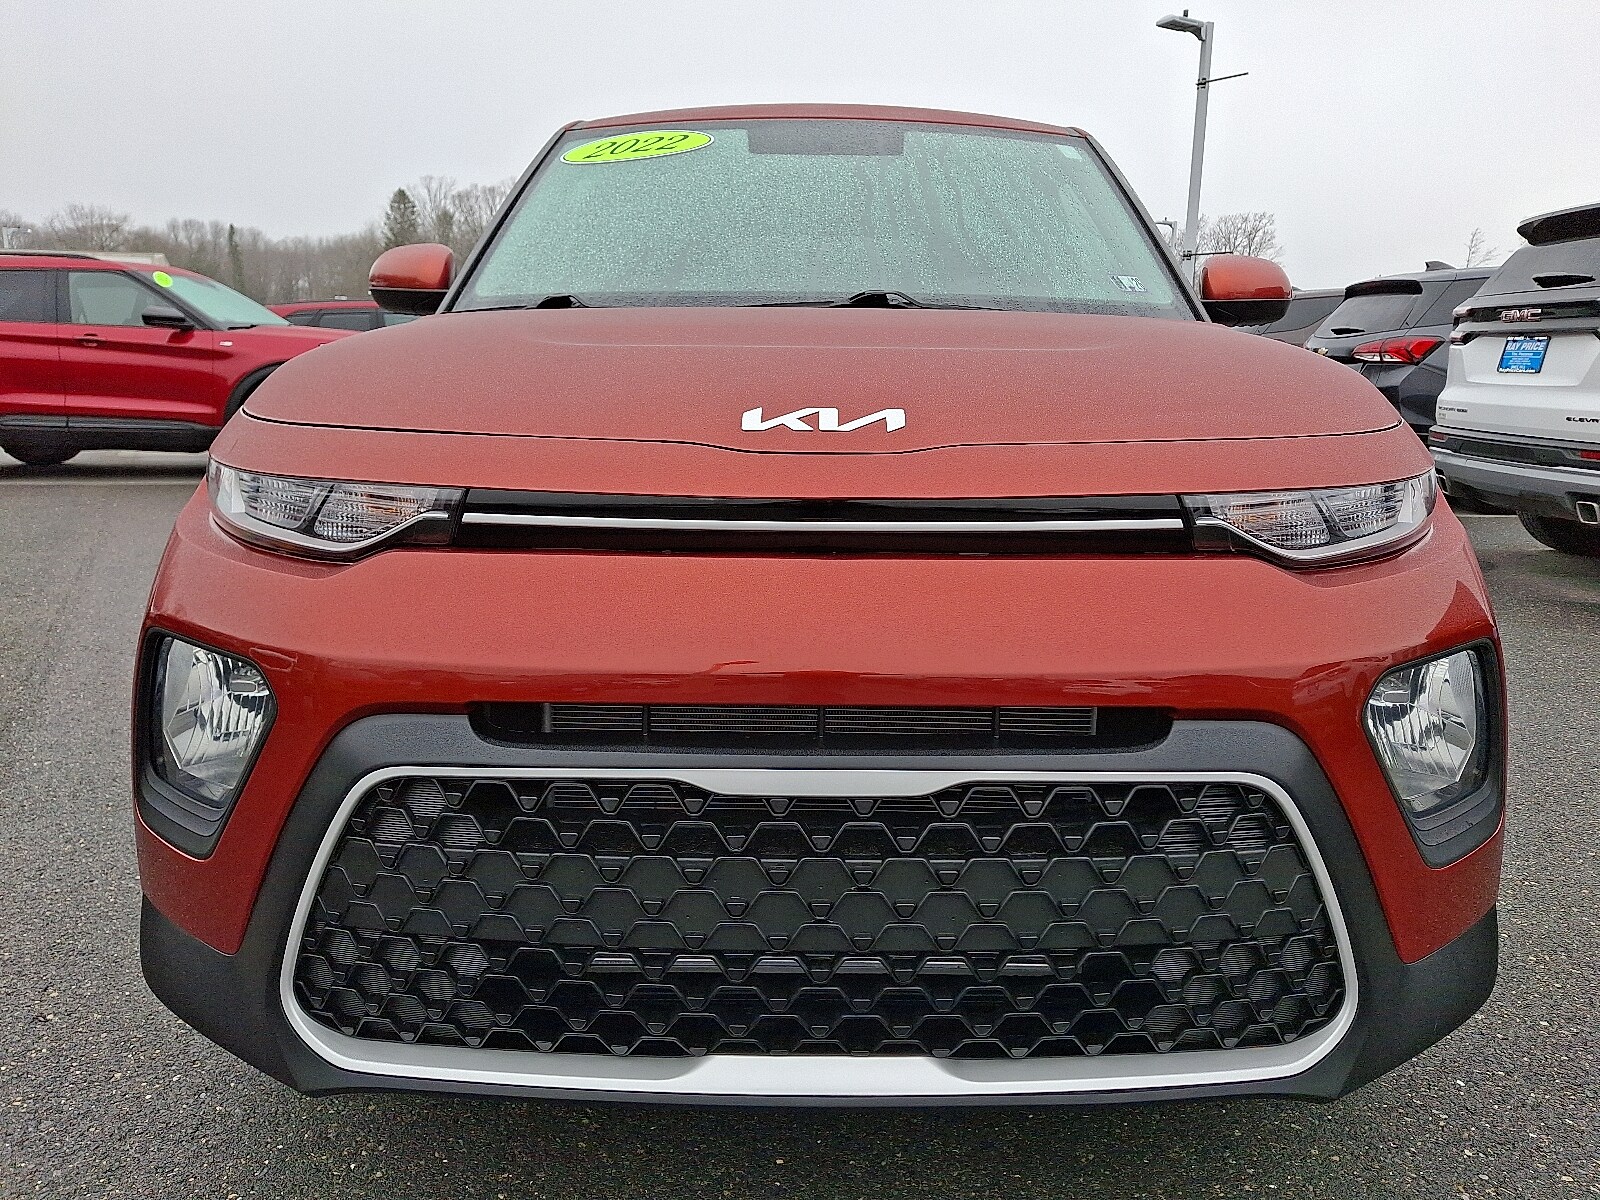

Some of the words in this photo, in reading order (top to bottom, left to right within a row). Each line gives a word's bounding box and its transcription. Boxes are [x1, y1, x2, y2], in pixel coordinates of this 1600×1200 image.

[583, 134, 690, 160] 2022
[1501, 309, 1541, 323] GMC
[1506, 342, 1521, 350] RAY
[1521, 342, 1546, 350] PRICE
